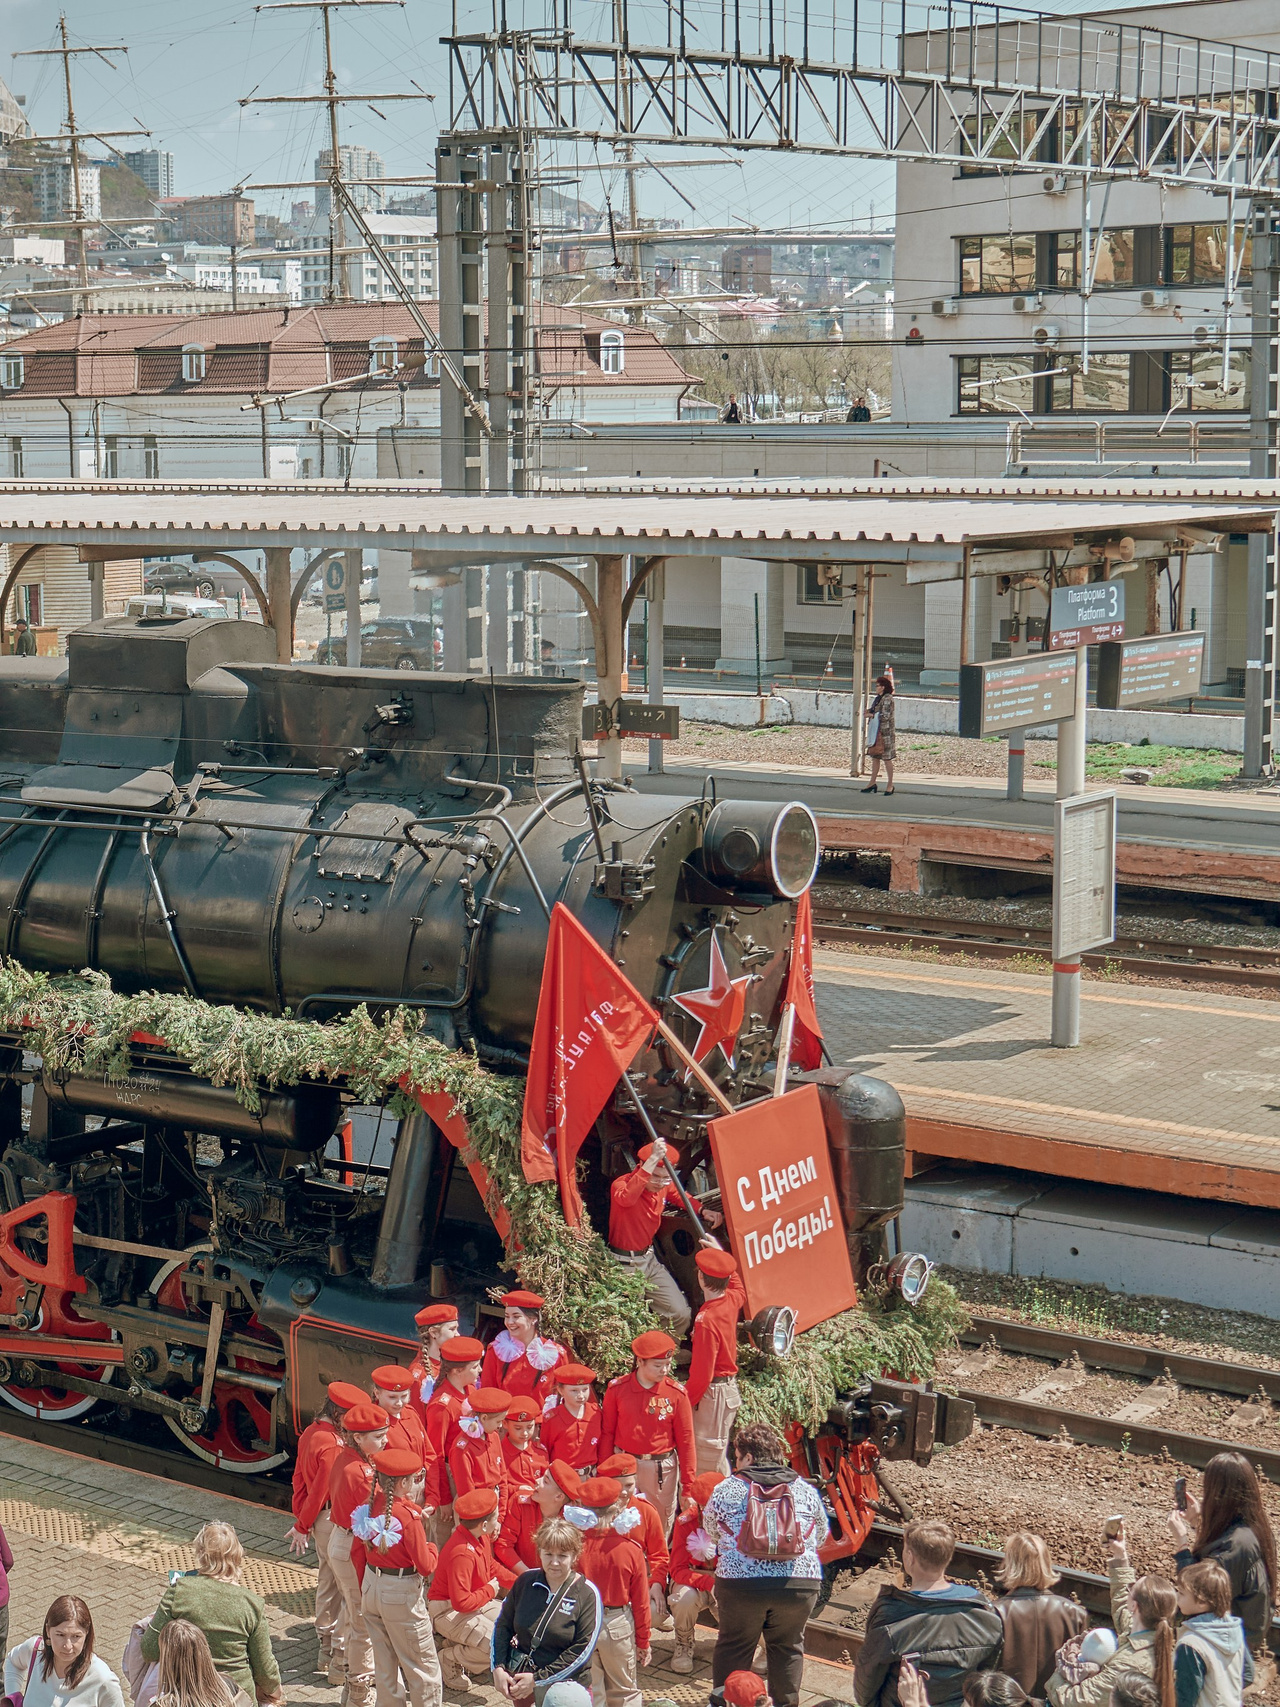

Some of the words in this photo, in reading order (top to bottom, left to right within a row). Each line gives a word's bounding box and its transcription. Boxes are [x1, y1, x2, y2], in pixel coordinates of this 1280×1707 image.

[1068, 588, 1106, 604] Платформа
[1109, 586, 1118, 617] 3
[1078, 606, 1106, 621] Platform
[1111, 625, 1116, 637] 4
[737, 1176, 755, 1212] С
[758, 1155, 818, 1211] Днем
[744, 1195, 834, 1269] Победы!
